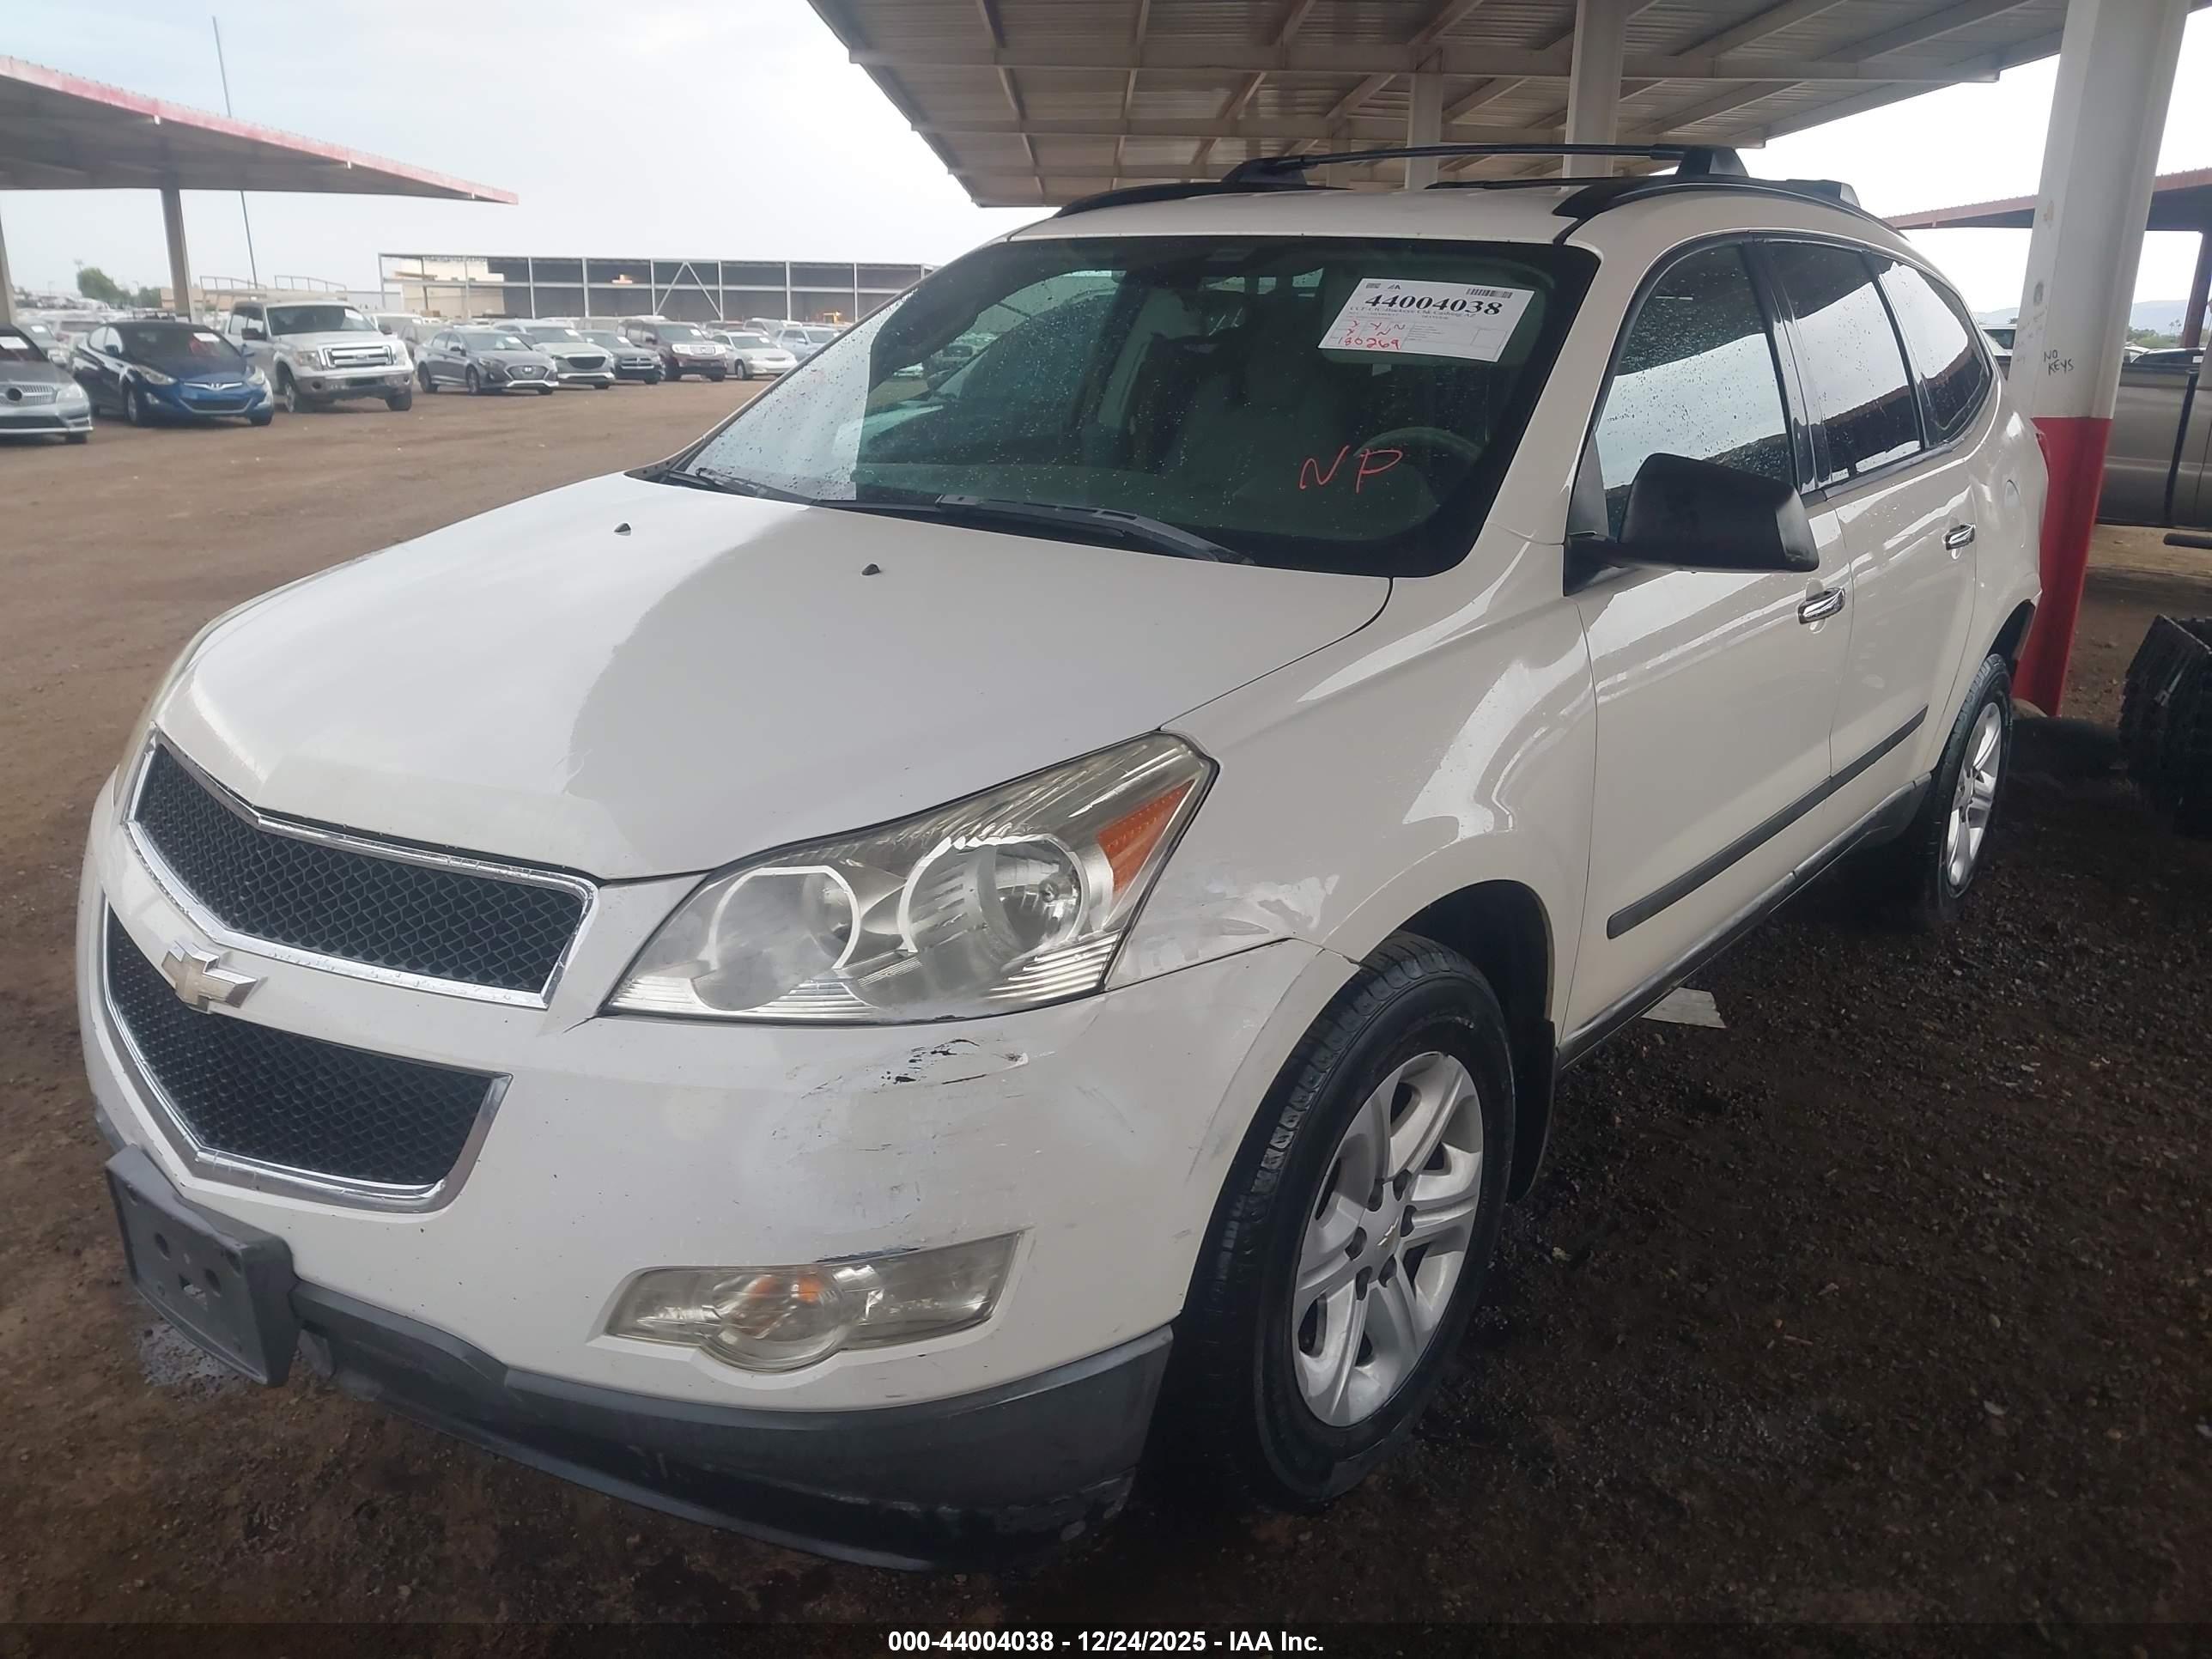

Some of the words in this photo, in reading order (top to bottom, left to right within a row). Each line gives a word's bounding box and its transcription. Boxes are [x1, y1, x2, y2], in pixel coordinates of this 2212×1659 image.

[1364, 294, 1504, 315] 44004038
[2043, 349, 2058, 362] NO
[2047, 359, 2075, 376] KEYS
